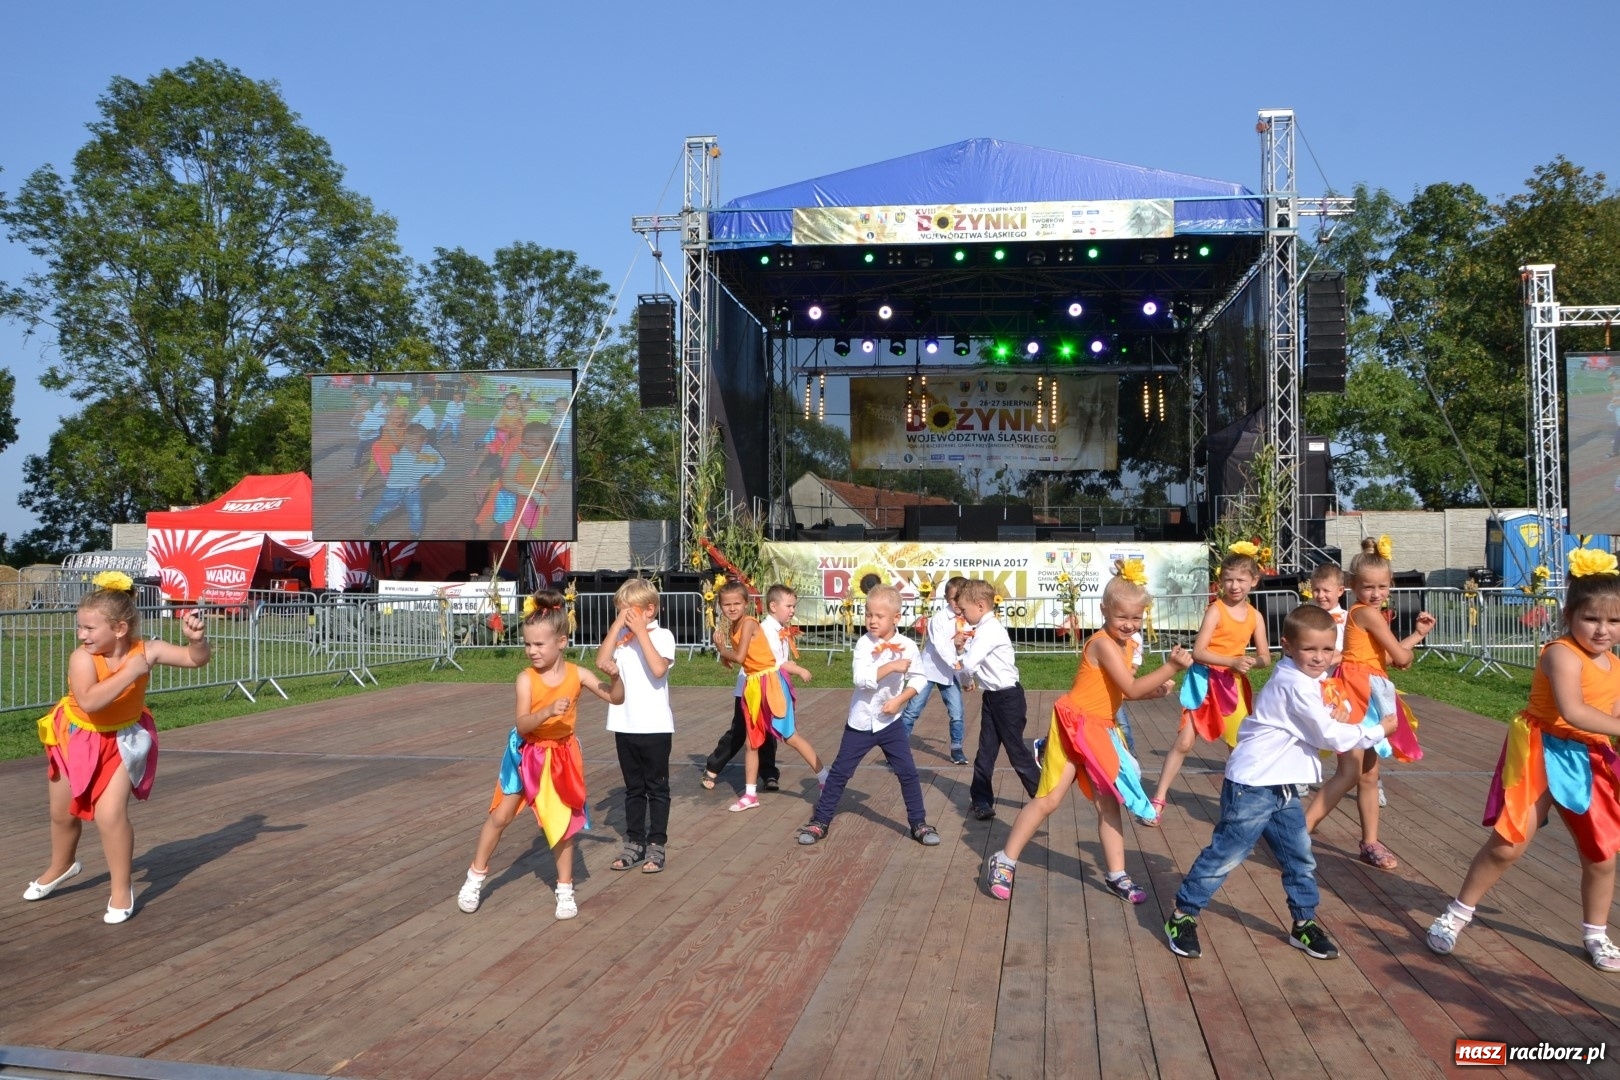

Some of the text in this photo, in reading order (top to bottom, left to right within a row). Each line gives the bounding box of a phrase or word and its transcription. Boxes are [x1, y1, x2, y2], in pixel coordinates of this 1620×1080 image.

[983, 231, 1027, 239] ŚLĄSKIEGO
[1039, 400, 1056, 408] 201
[906, 431, 1057, 444] WOJEWÓDZTWA ŚLĄSKIEGO
[222, 499, 283, 512] WARKA
[818, 556, 858, 568] XVIII
[922, 558, 1028, 567] 26-27 SIERPNIA 2017
[205, 569, 246, 583] WARKA
